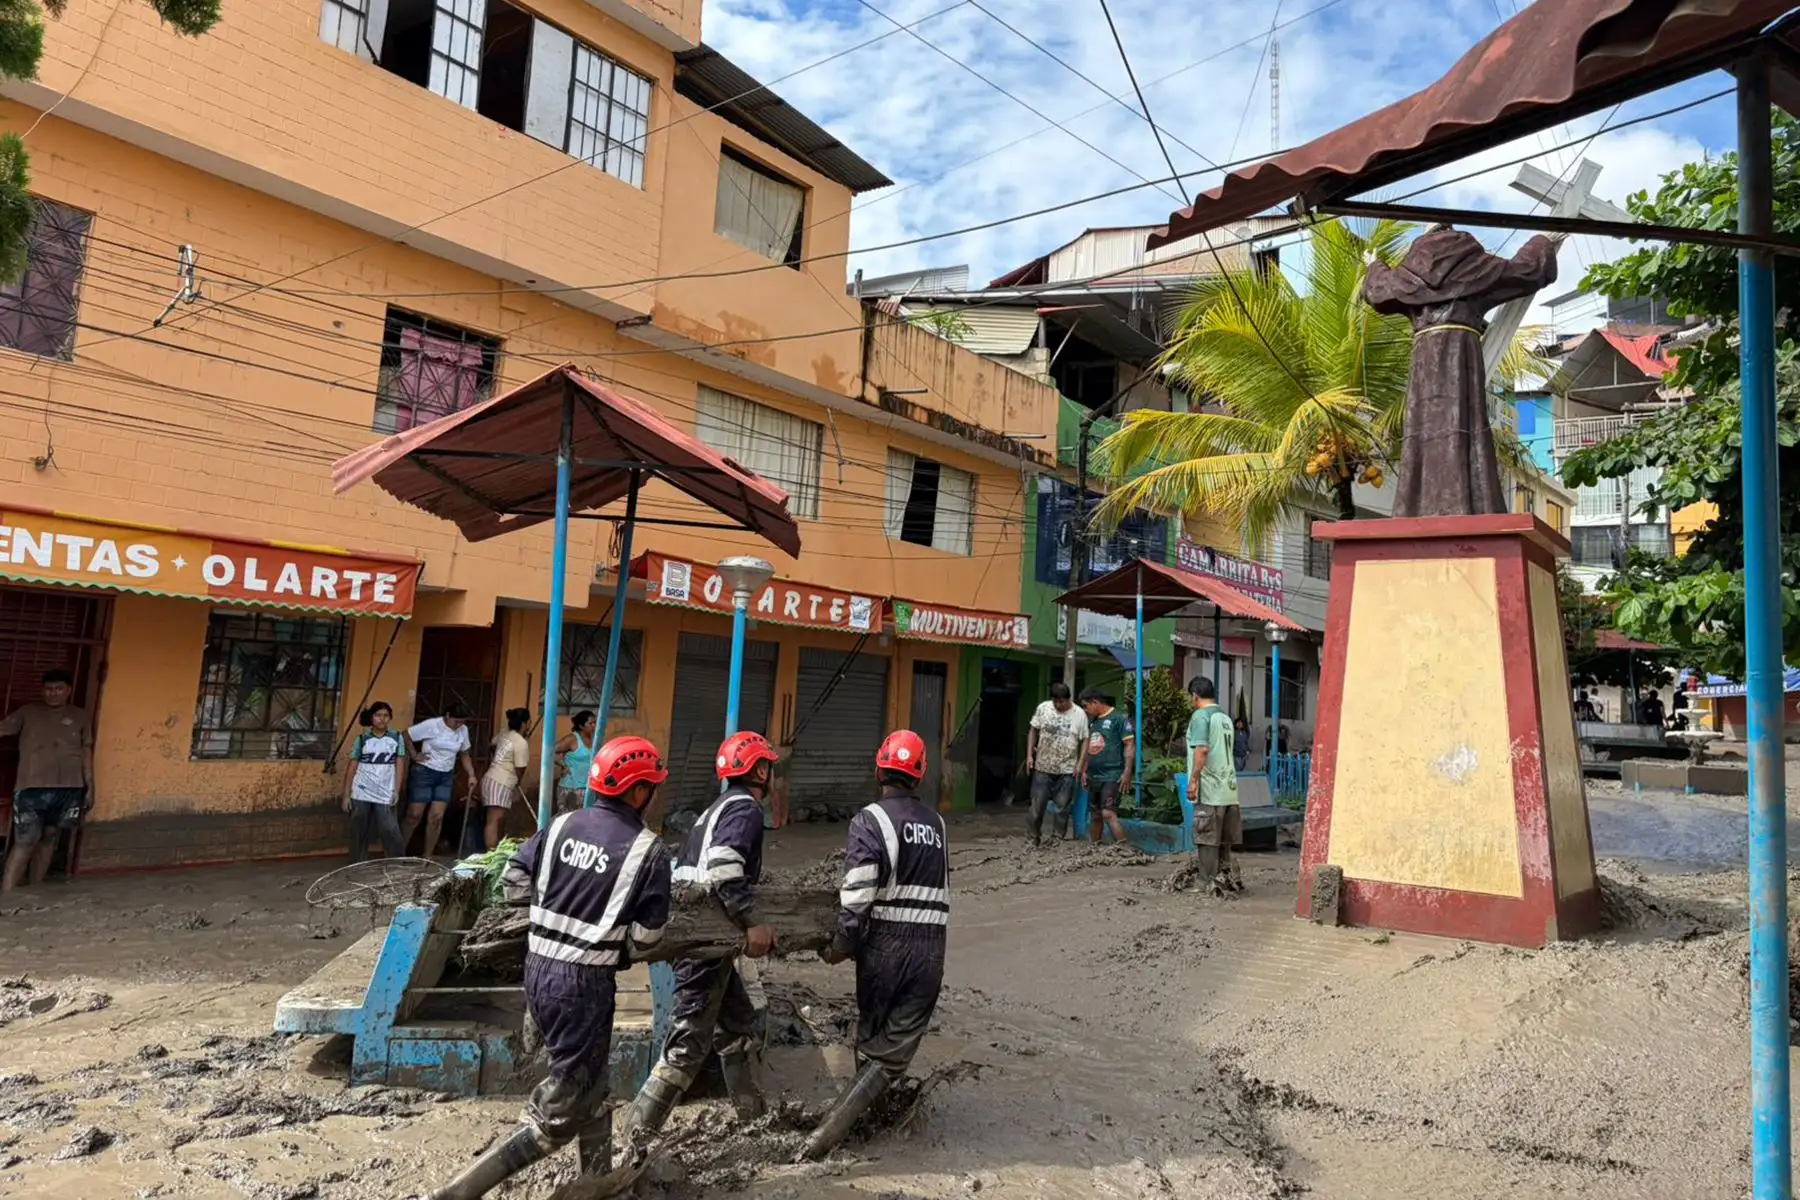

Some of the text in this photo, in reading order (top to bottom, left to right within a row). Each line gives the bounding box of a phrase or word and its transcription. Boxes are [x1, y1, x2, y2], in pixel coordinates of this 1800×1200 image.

[202, 554, 397, 604] OLARTE
[665, 587, 685, 599] BASA
[703, 574, 846, 622] OARTE
[910, 608, 1014, 641] MULTIVENTAS
[903, 822, 942, 849] CIRD's
[560, 838, 610, 874] CIRD's
